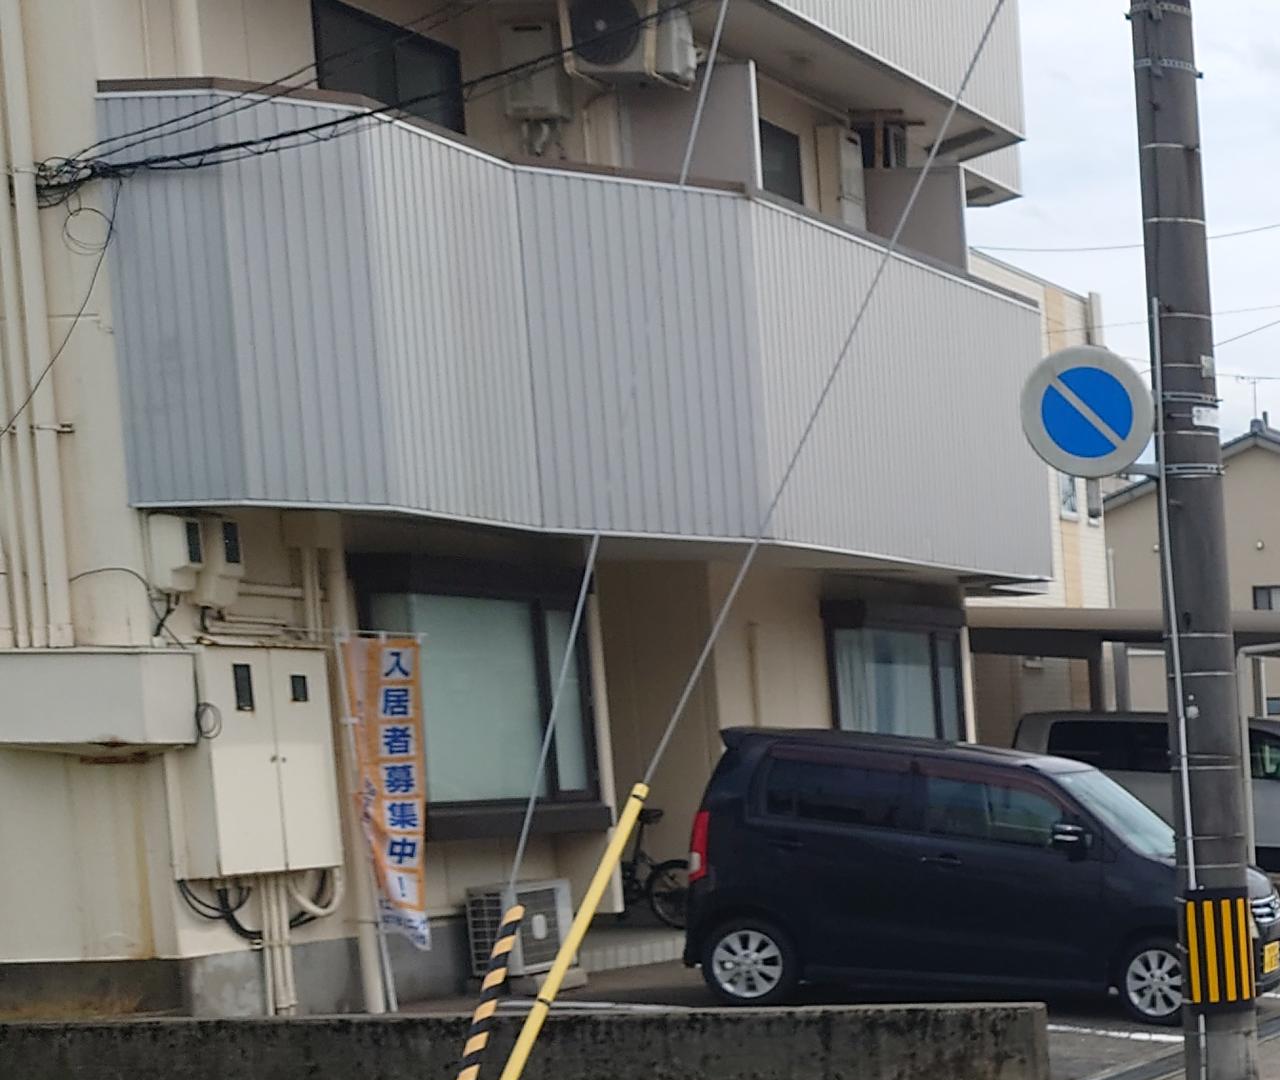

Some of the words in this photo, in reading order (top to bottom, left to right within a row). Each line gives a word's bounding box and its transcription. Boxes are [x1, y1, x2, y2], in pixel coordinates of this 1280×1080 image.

[382, 650, 418, 898] 入居者募集中！
